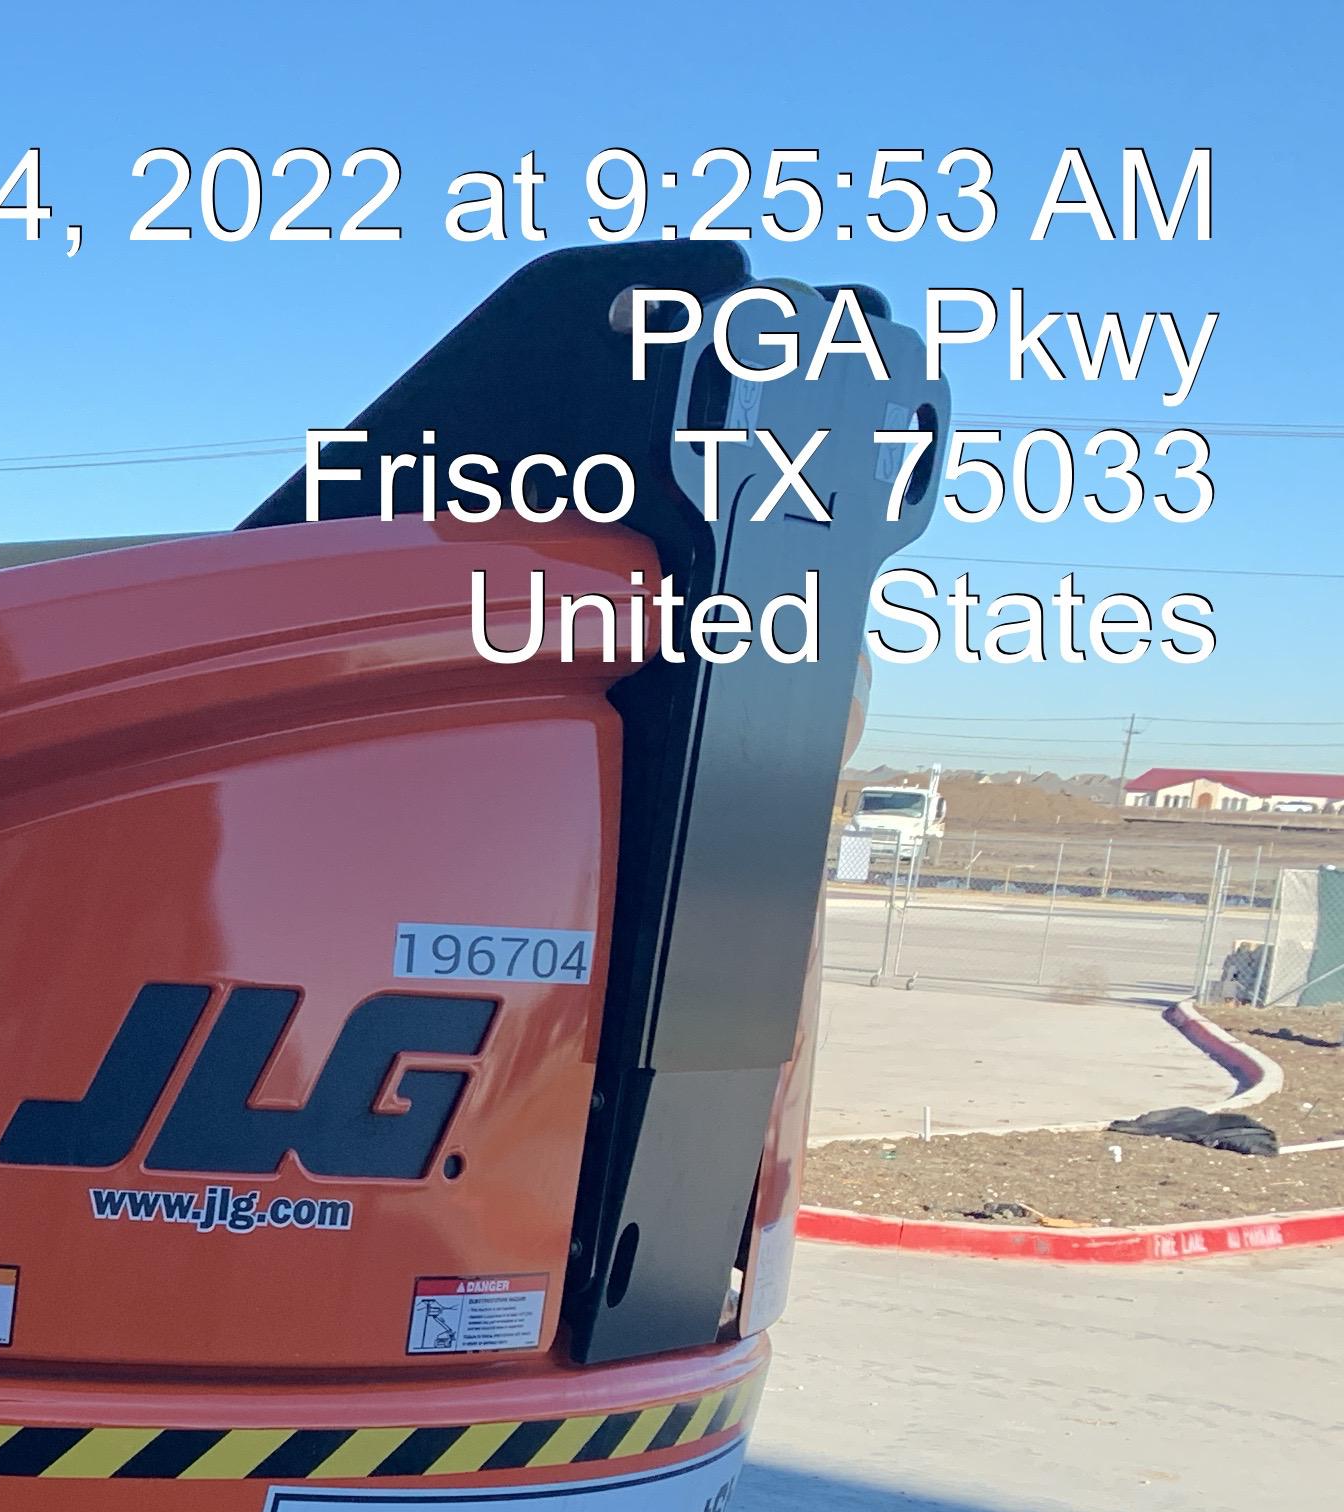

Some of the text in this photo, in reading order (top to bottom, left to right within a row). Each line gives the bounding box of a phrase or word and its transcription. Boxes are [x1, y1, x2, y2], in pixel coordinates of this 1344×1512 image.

[400, 933, 587, 980] 196704
[89, 1186, 353, 1232] www.jlg.com
[465, 1279, 511, 1293] DANGER
